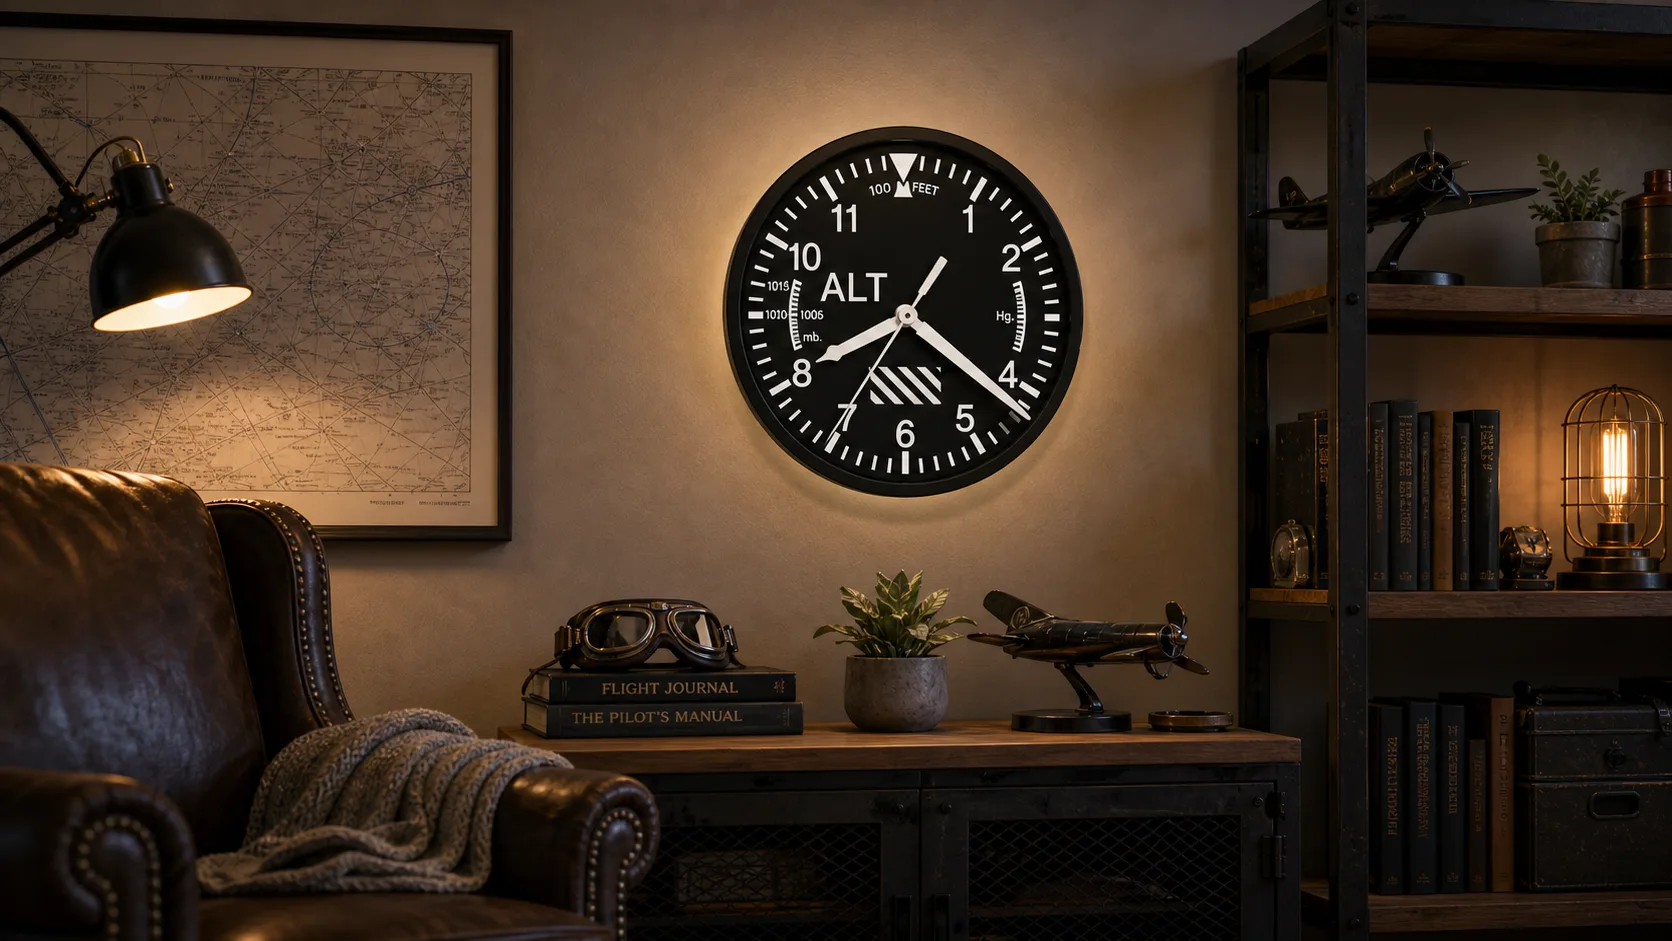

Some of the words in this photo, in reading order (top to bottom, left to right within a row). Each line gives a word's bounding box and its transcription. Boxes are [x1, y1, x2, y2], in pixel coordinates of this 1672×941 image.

[868, 182, 892, 197] 100
[912, 181, 940, 197] FEET
[831, 203, 857, 233] 11
[962, 203, 974, 234] 1
[788, 242, 822, 272] 10
[1001, 242, 1021, 273] 2
[820, 272, 888, 303] ALT
[765, 309, 788, 321] 1010
[996, 310, 1015, 325] Hg.
[803, 331, 823, 343] mb.
[792, 359, 812, 387] 8
[998, 360, 1018, 389] 4
[837, 403, 858, 433] 7
[955, 403, 976, 433] 5
[895, 419, 916, 448] 6
[602, 681, 660, 695] FLIGHT
[664, 681, 739, 695] JOURNAL
[572, 711, 604, 724] THE
[609, 710, 670, 724] PILOT'S
[675, 709, 743, 723] MANUAL
